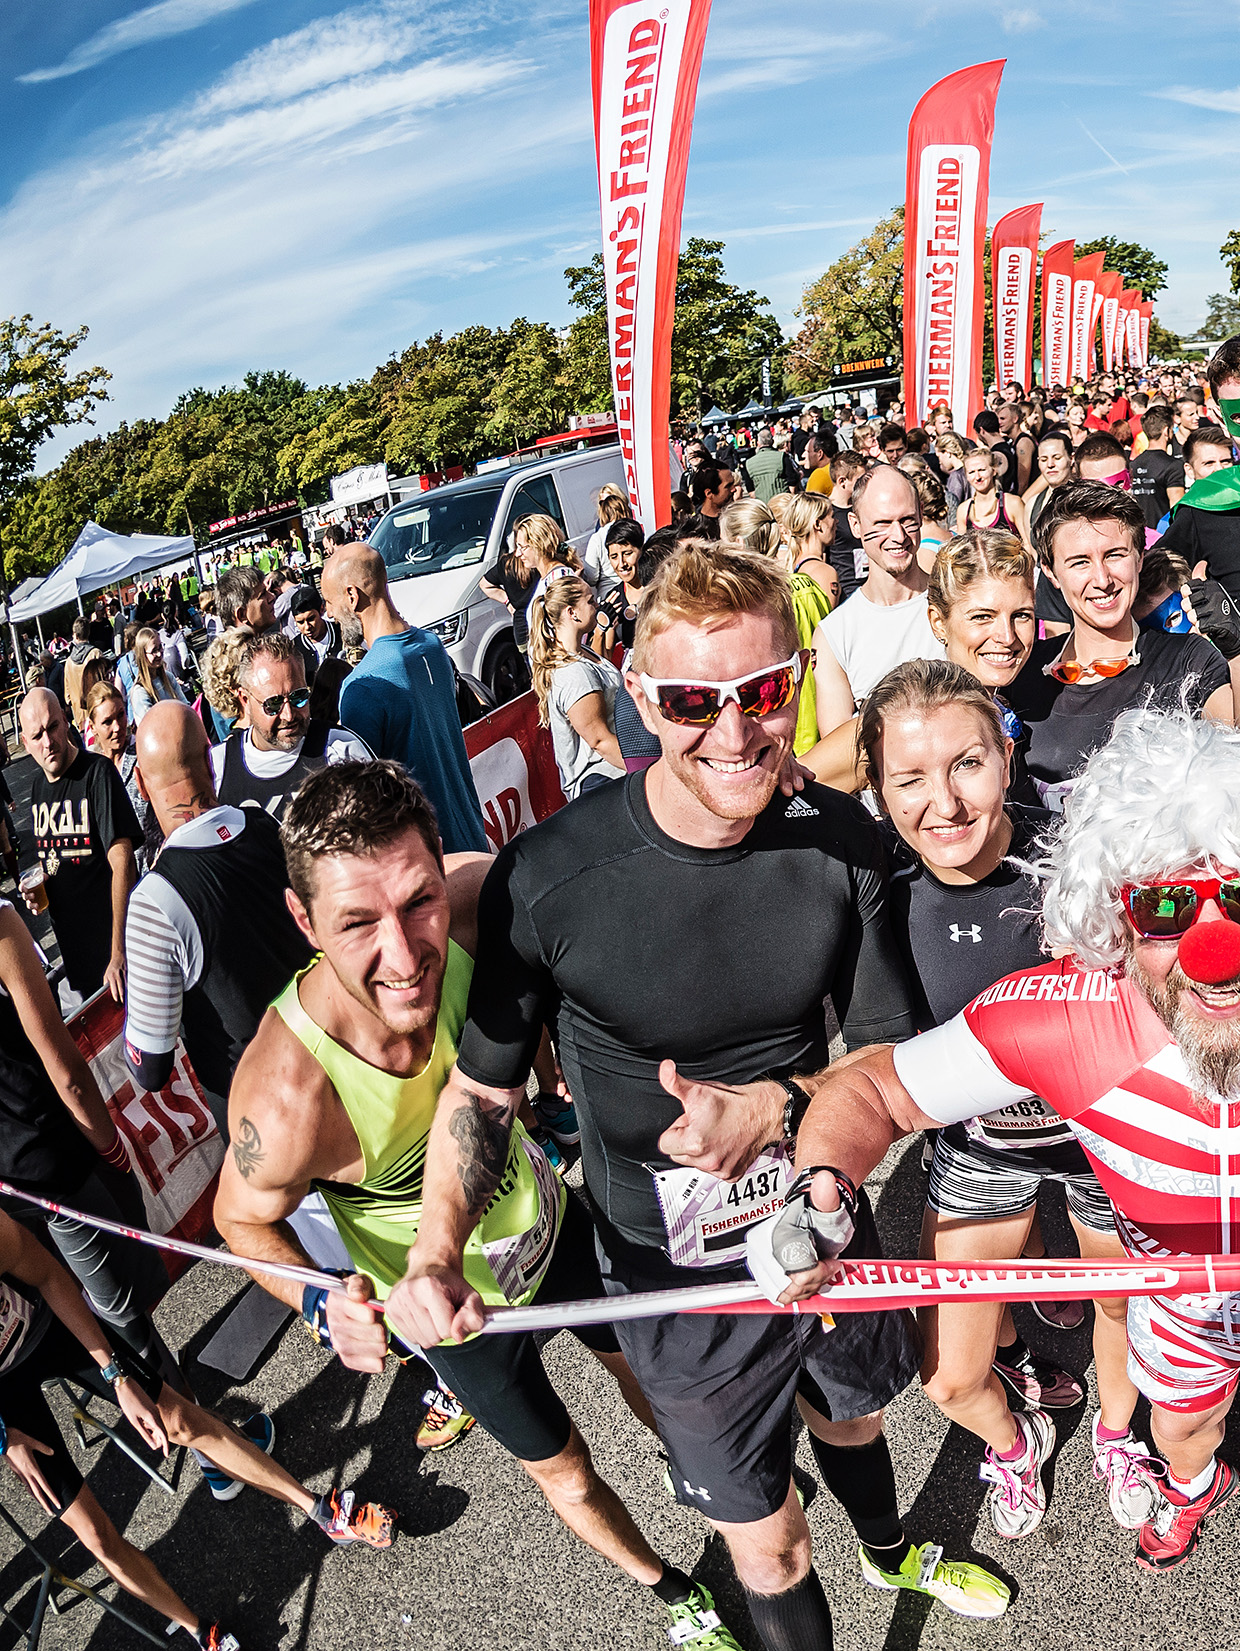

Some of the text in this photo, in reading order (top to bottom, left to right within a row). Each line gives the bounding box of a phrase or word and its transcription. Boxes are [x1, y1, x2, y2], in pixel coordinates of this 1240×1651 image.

[610, 18, 661, 202] FRIEND
[926, 157, 960, 415] SHERMAN'S FRIEND
[1003, 254, 1021, 306] FRIEND
[1053, 278, 1065, 320] FRIEND
[1075, 285, 1089, 320] FRIEND
[841, 358, 885, 374] BRENNWERK
[784, 808, 820, 818] adidas
[970, 969, 1118, 1014] POWERSLIDE
[727, 1167, 780, 1206] 4437
[701, 1203, 771, 1236] FISHERMAN'S
